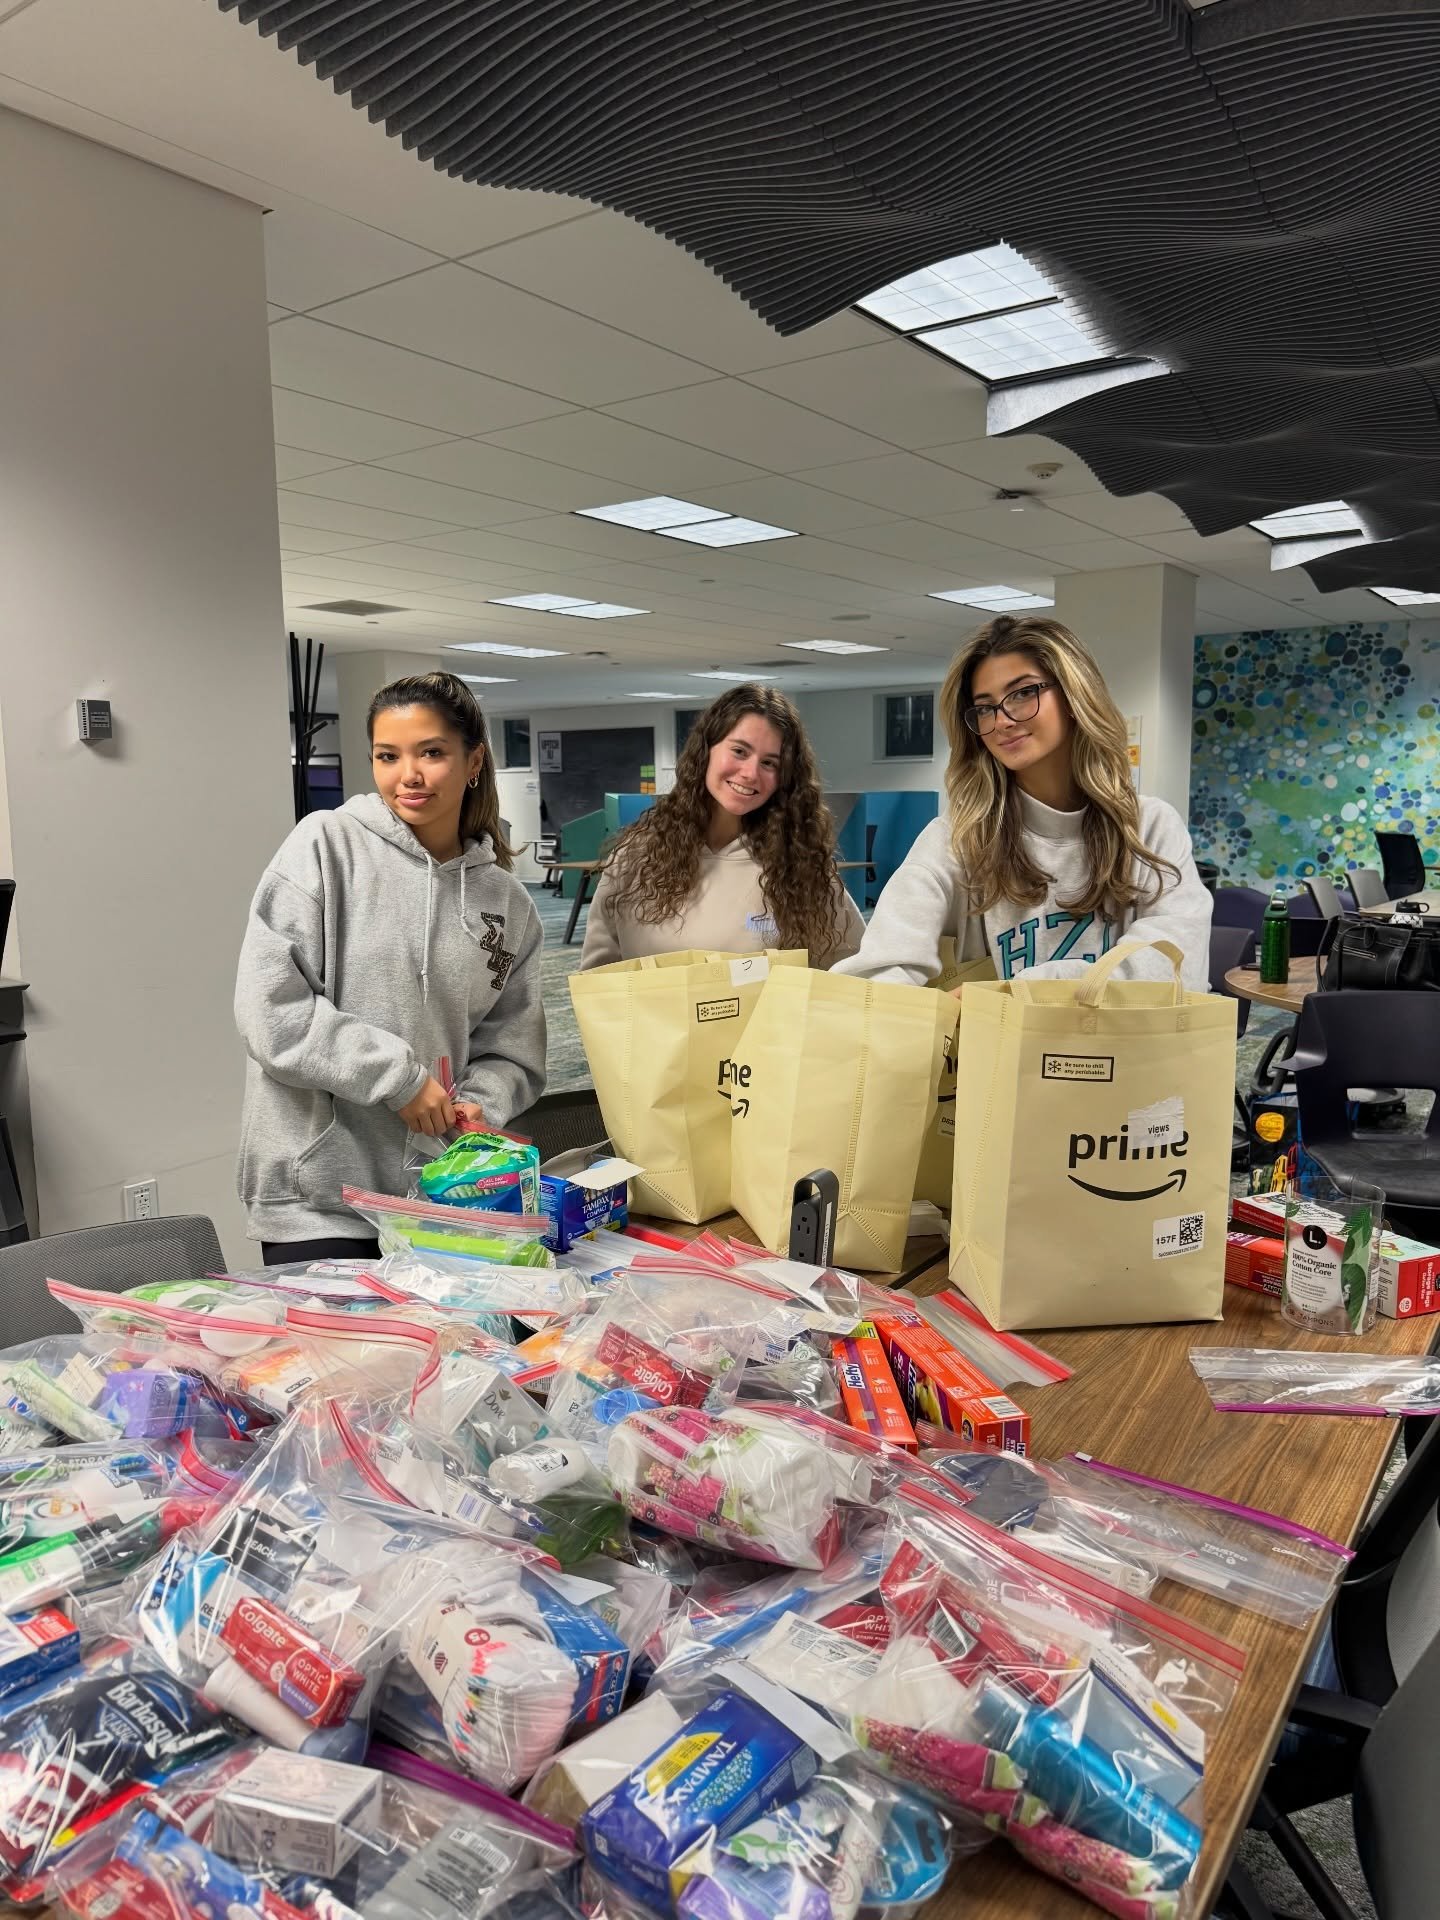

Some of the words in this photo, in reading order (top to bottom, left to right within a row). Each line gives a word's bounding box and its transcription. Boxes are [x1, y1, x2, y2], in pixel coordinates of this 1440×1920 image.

[997, 911, 1113, 980] HZ
[1147, 1123, 1170, 1135] views
[582, 1195, 610, 1214] TAMPAX
[586, 1205, 607, 1219] COMPACT
[1156, 1234, 1177, 1245] 157F
[1292, 1252, 1307, 1263] 100%
[1307, 1257, 1337, 1270] Organic
[1292, 1260, 1313, 1273] Cotton
[1313, 1267, 1332, 1277] Core
[1424, 1290, 1432, 1308] Bags
[1299, 1313, 1334, 1327] TAMPONS
[634, 1364, 673, 1400] Colgate
[845, 1363, 863, 1388] Hefty
[484, 1391, 506, 1420] Dove
[986, 1433, 996, 1444] 15
[1201, 1546, 1225, 1560] SEAL
[1203, 1542, 1248, 1563] TRUSTED
[201, 1602, 227, 1625] REAC
[238, 1603, 286, 1648] Colgate
[864, 1622, 892, 1633] WHIT
[298, 1658, 326, 1684] OPTIC
[293, 1668, 319, 1696] WHITE
[283, 1682, 315, 1712] ADVANCED
[106, 1680, 183, 1750] Barbasol
[666, 1740, 738, 1806] TAMPAX
